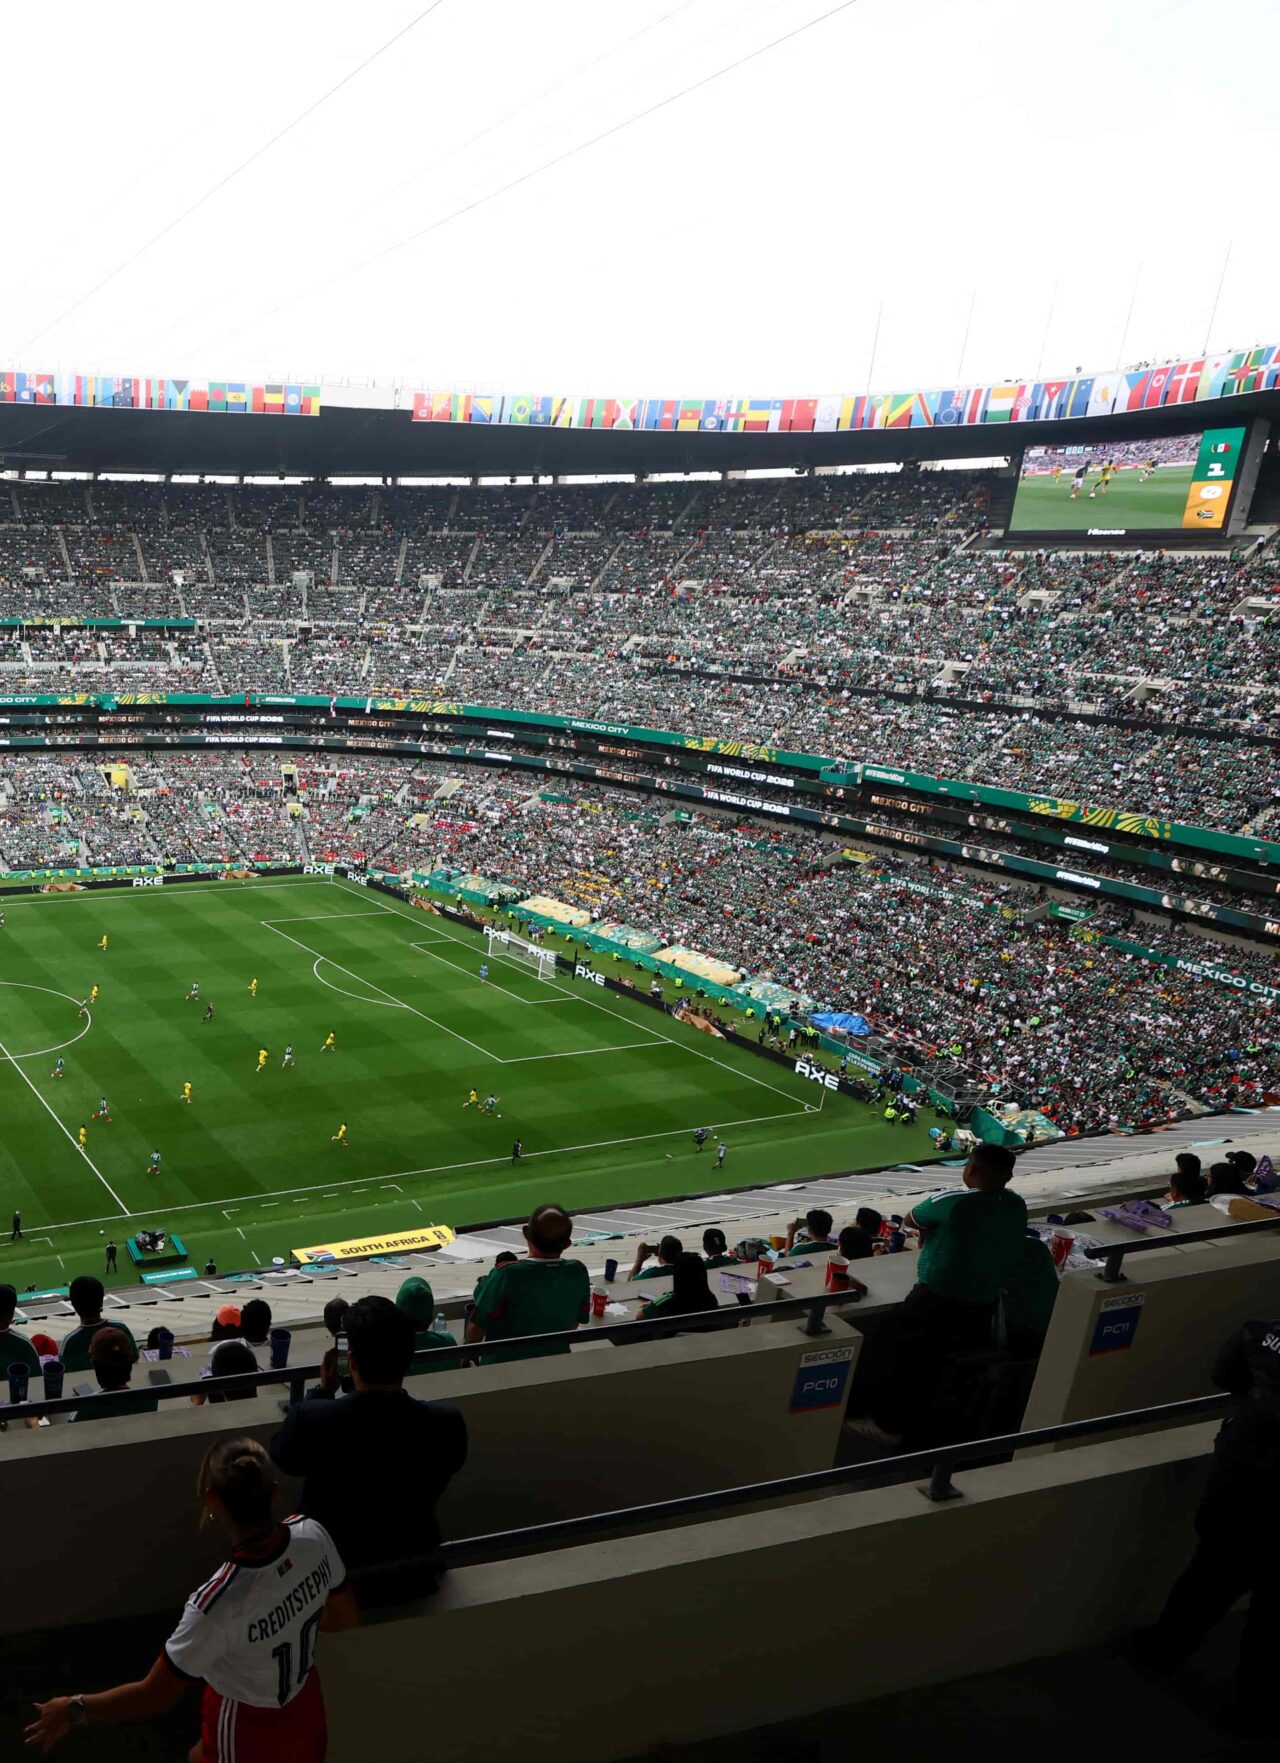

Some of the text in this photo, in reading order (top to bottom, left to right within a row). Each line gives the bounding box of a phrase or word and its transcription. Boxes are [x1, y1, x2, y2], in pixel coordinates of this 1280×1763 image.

[1207, 463, 1224, 476] 1
[348, 719, 376, 727] MEXICO
[571, 720, 628, 734] MEXICO CITY
[346, 740, 374, 748] MEXICO
[599, 745, 643, 757] MEXICO CITY
[596, 769, 640, 782] MEXICO CITY
[707, 764, 794, 787] FIFA WORLD CUP 2026
[704, 790, 789, 814] FIFA WORLD CUP 2026
[871, 795, 932, 814] MEXICO CITY
[865, 825, 926, 844] MEXICO CITY
[304, 866, 334, 874] AXE
[133, 876, 163, 887] AXE
[347, 872, 367, 886] AXE
[938, 891, 954, 900] CUP
[483, 926, 510, 943] AXE
[575, 964, 605, 986] AXE
[1176, 960, 1280, 998] MEXICO CIT
[795, 1060, 839, 1090] AXE
[340, 1236, 430, 1255] SOUTH AFRICA
[1102, 1322, 1130, 1336] PC11
[803, 1377, 838, 1393] PC10
[248, 1554, 332, 1642] CREDITSTEPHY
